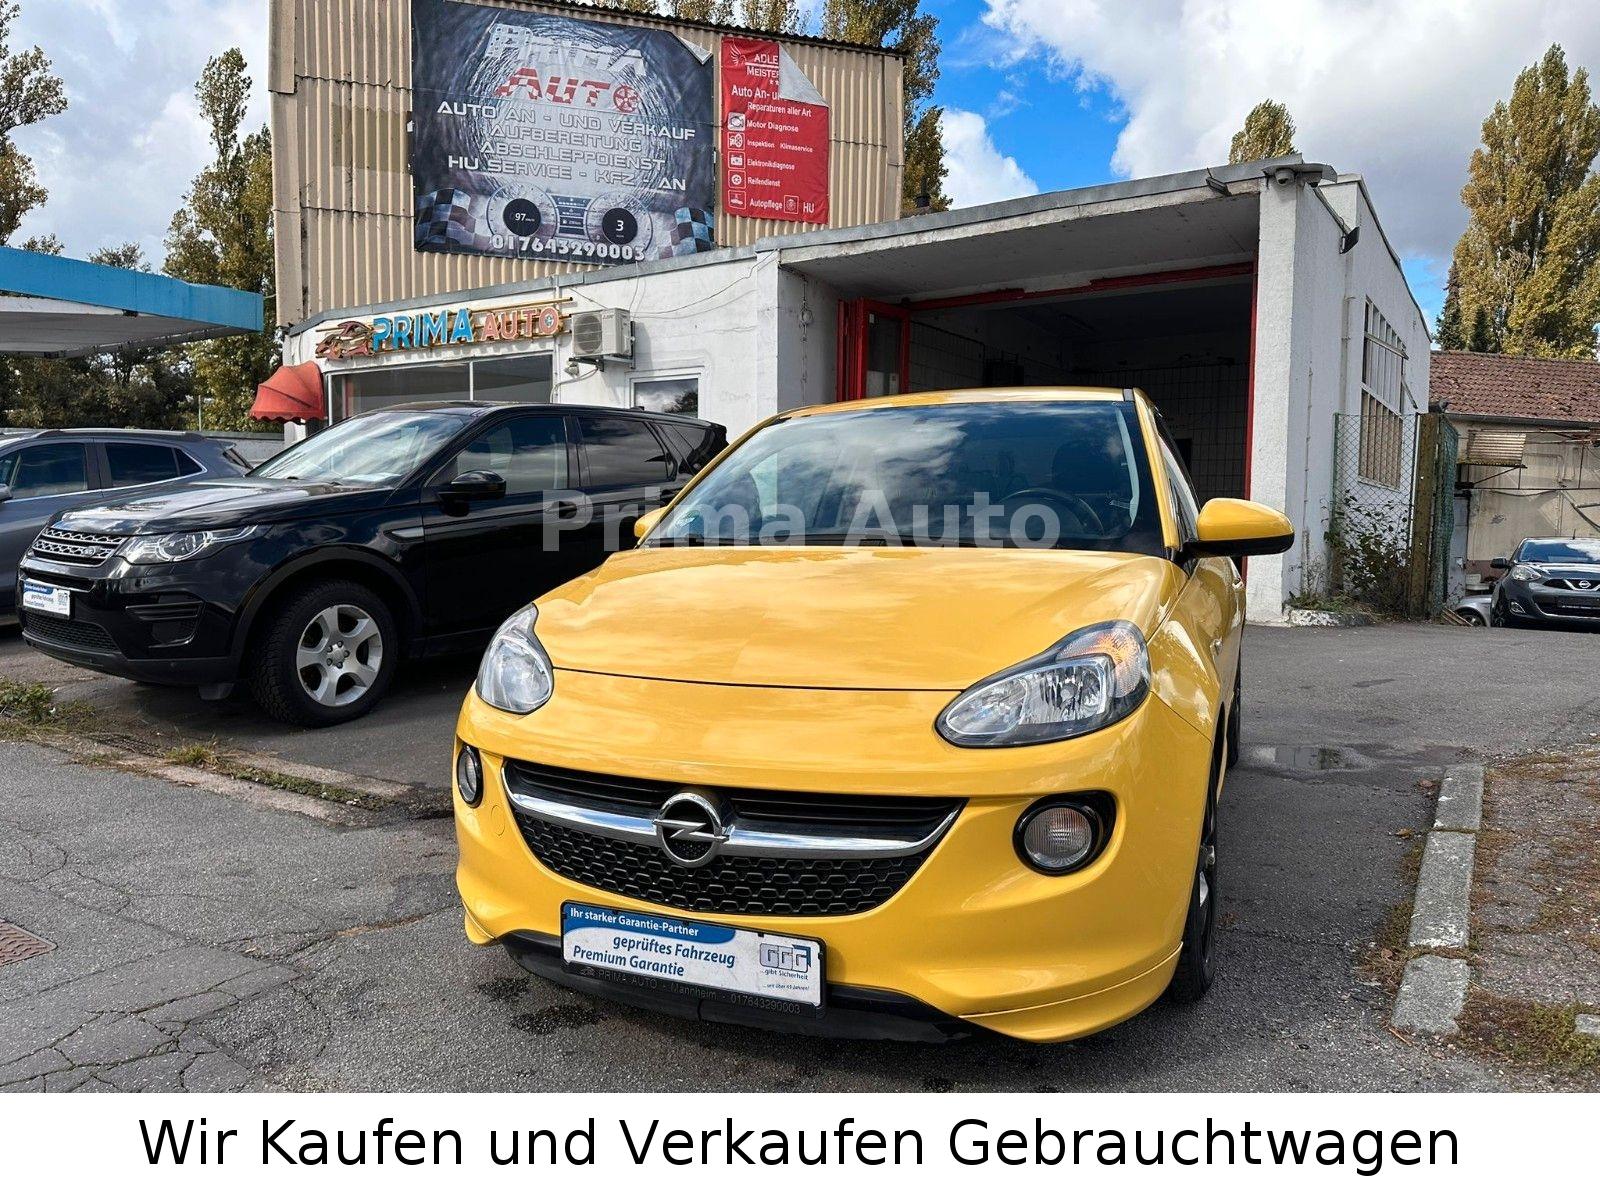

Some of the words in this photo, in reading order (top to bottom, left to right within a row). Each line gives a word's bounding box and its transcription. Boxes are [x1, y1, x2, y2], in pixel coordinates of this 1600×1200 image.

[754, 53, 779, 64] ADLE
[731, 84, 753, 98] Auto
[747, 101, 786, 114] Reparaturen
[787, 106, 801, 116] aller
[801, 108, 812, 117] Art
[437, 101, 497, 119] AUTO
[505, 108, 536, 124] AN
[560, 113, 601, 131] UND
[609, 119, 697, 141] VERKAUF
[746, 120, 766, 129] Motor
[767, 121, 799, 132] Diagnose
[490, 123, 642, 153] AUFBEREITUNG
[747, 139, 775, 149] Inspektion
[780, 142, 813, 153] Klimaservice
[480, 141, 666, 172] ABSCHLEPPDIENST
[747, 158, 795, 170] Elektronikdiagnose
[448, 155, 478, 170] HU
[487, 159, 572, 180] SERVICE
[595, 169, 637, 187] KFZ
[659, 177, 686, 191] AN
[747, 176, 781, 187] Reifendienst
[750, 198, 783, 210] Autopflege
[803, 201, 815, 213] HU
[515, 212, 526, 221] 97
[615, 219, 624, 231] 3
[491, 234, 645, 261] 017643290003
[371, 307, 475, 351] PRIMA
[480, 306, 561, 342] AUTO
[570, 907, 583, 918] Ihr
[584, 910, 617, 924] starker
[618, 915, 699, 937] Garantie-Partner
[613, 936, 672, 955] geprüftes
[674, 943, 736, 969] Fahrzeug
[573, 945, 626, 967] Premium
[629, 955, 685, 977] Garantie
[778, 969, 809, 980] Sicherheit
[631, 973, 657, 990] AUTO
[670, 982, 717, 1001] Mannheim
[731, 993, 801, 1015] 017643290003
